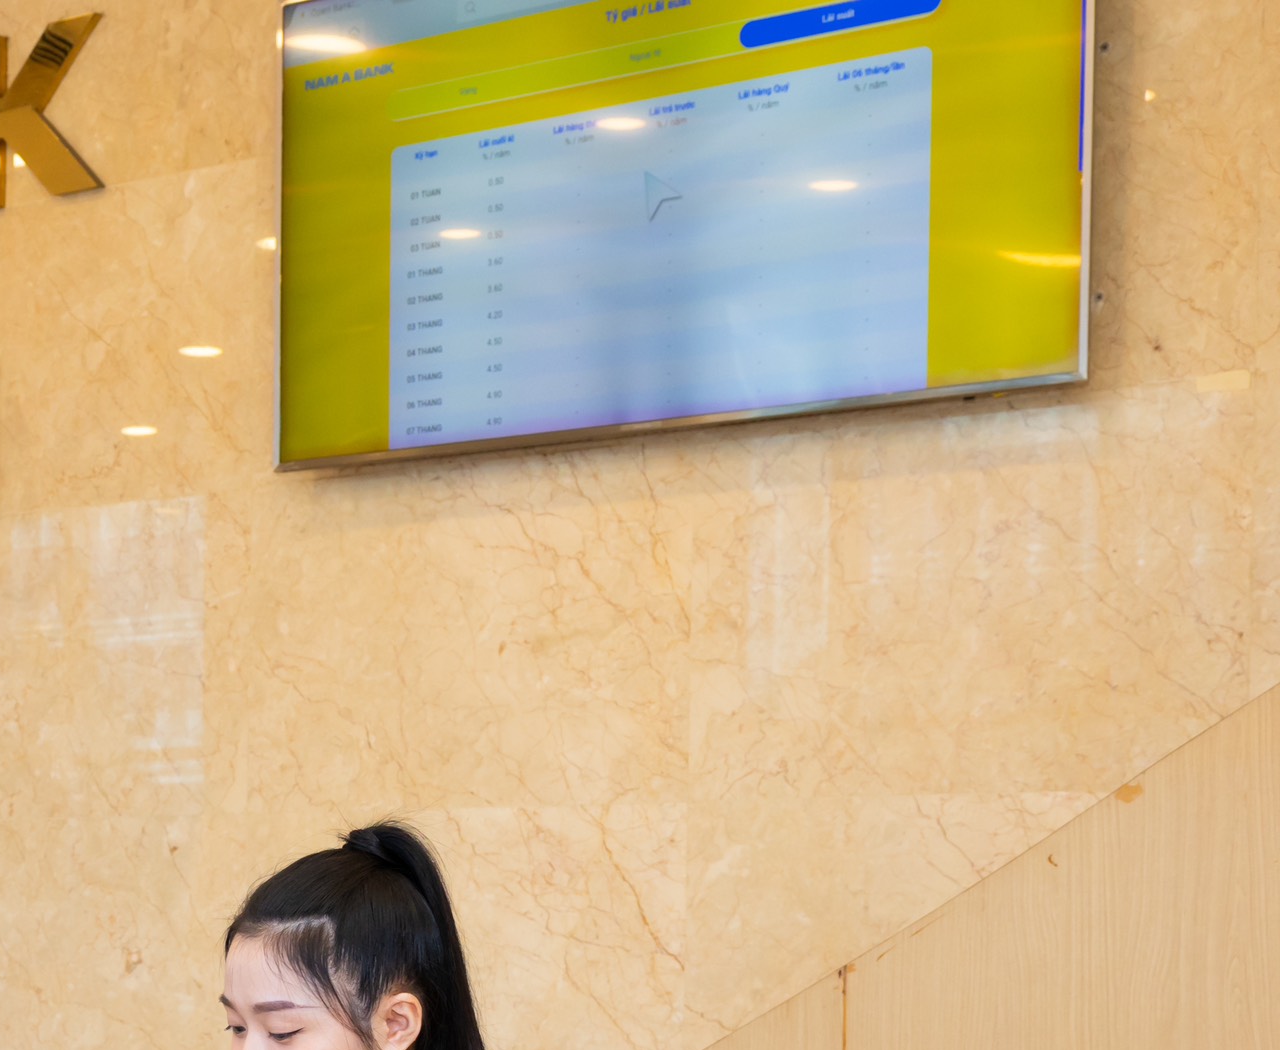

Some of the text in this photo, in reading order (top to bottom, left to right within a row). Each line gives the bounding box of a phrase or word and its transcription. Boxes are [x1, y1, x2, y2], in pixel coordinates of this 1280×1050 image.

[305, 62, 394, 91] NAM A BANK
